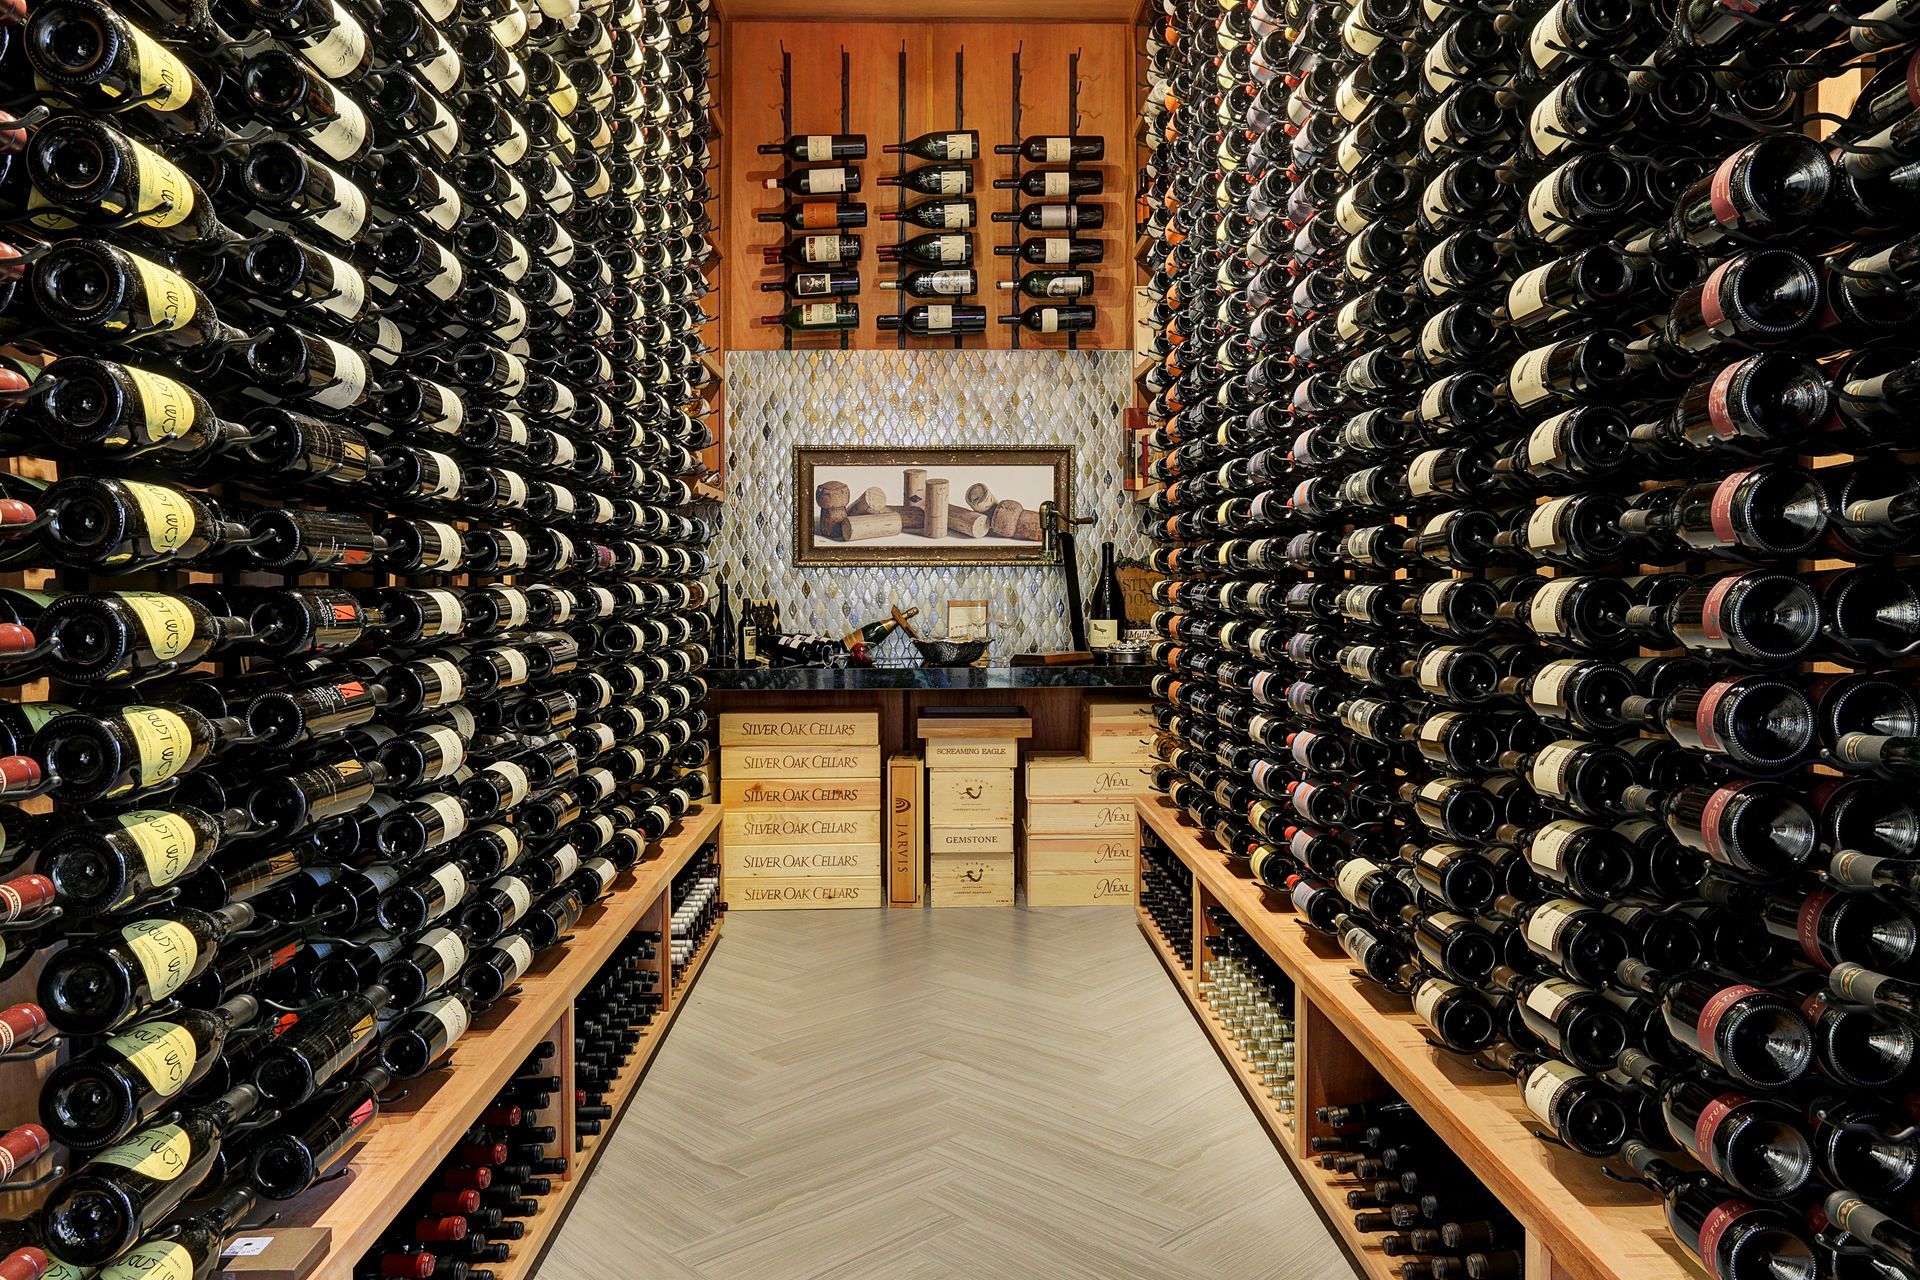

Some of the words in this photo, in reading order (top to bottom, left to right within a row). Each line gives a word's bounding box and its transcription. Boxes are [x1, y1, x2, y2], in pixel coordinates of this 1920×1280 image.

[742, 722, 779, 736] SILVER
[780, 722, 807, 735] OAK
[810, 722, 856, 736] CELLARS
[744, 755, 781, 769] SILVER
[783, 755, 809, 768] OAK
[812, 755, 858, 768] CELLARS
[744, 788, 781, 802] SILVER
[783, 788, 810, 801] OAK
[812, 788, 858, 801] CELLARS
[744, 821, 781, 836] SILVER
[783, 821, 809, 834] OAK
[812, 820, 858, 834] CELLARS
[945, 835, 998, 844] GEMSTONE
[895, 823, 909, 873] JARVIS
[744, 855, 781, 868] SILVER
[783, 854, 809, 867] OAK
[812, 854, 858, 867] CELLARS
[745, 888, 782, 901] SILVER
[784, 887, 811, 900] OAK
[813, 887, 859, 900] CELLARS
